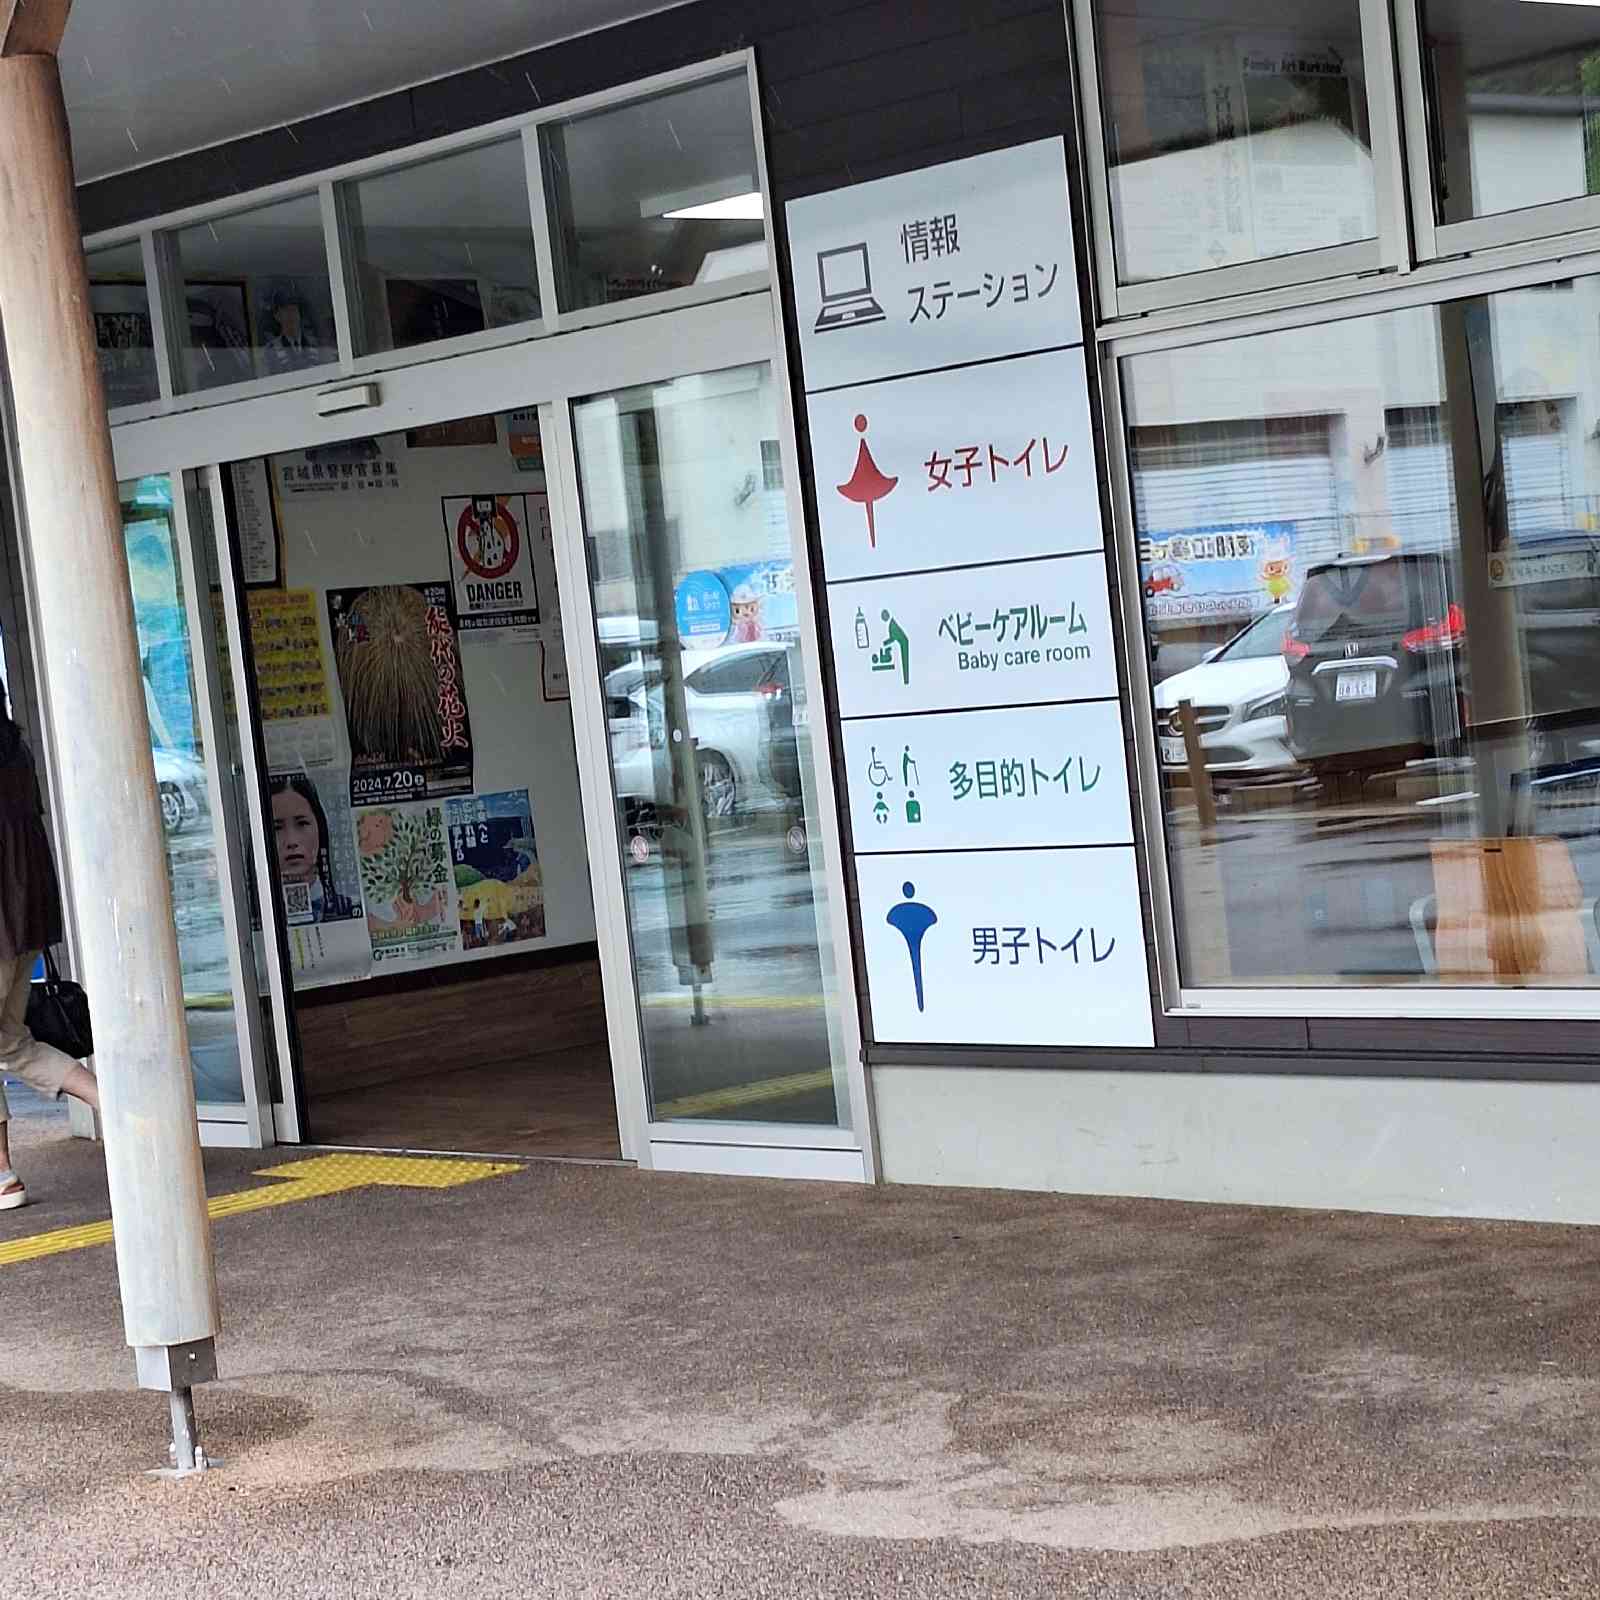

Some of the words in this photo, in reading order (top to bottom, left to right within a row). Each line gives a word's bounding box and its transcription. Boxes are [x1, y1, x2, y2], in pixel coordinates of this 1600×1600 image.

[901, 214, 961, 263] 情報
[907, 263, 1059, 324] ステーション
[924, 437, 1069, 493] 女子トイレ
[466, 581, 523, 603] DANGER
[937, 601, 1088, 646] ベビーケアルーム
[424, 607, 469, 750] 能代の花火
[958, 651, 999, 672] Baby
[1004, 649, 1041, 665] care
[1045, 645, 1091, 661] room
[948, 756, 1102, 800] 多目的トイレ
[970, 926, 1116, 965] 男子トイレ
